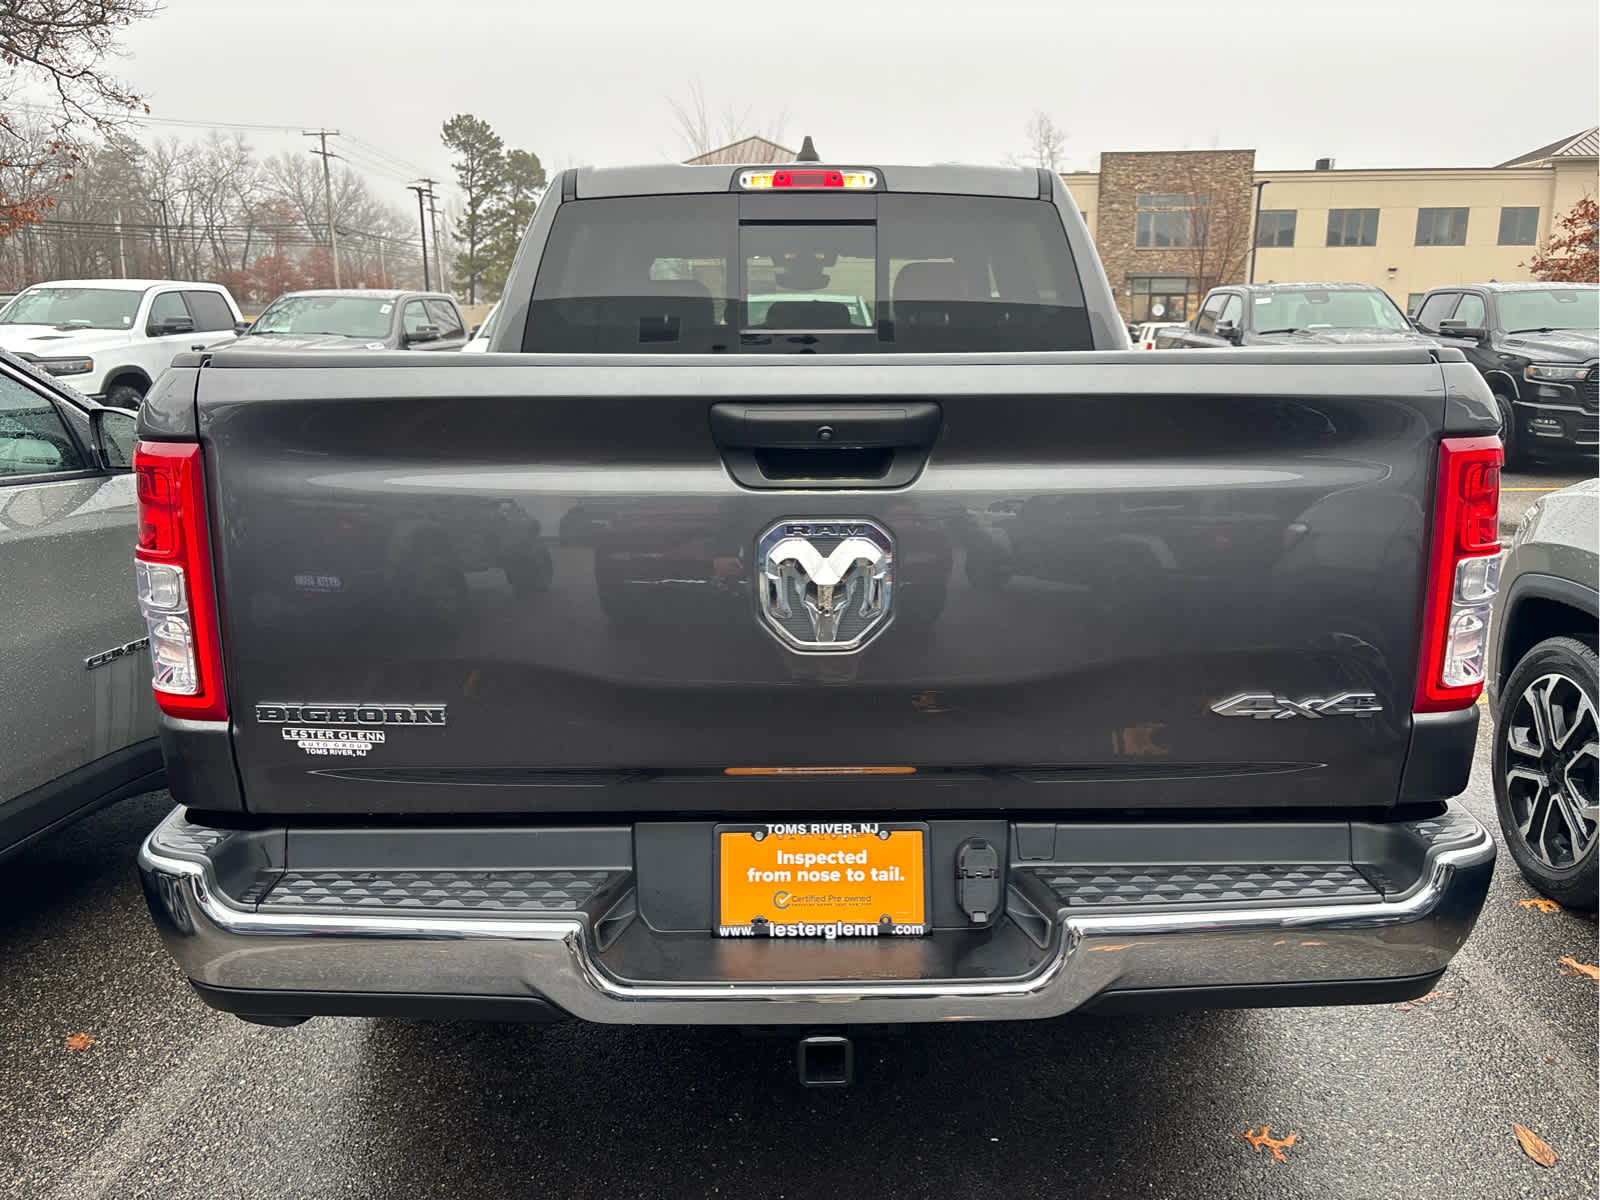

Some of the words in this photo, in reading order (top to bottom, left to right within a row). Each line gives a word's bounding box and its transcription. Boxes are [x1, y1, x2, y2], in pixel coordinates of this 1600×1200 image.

[784, 525, 865, 536] RAM
[83, 636, 151, 670] COMP
[255, 703, 447, 726] BIGHORN
[281, 728, 335, 740] LESTER
[338, 731, 385, 743] GLENN
[334, 742, 370, 750] GROUP
[766, 824, 807, 834] TOMS
[811, 824, 857, 835] RIVER,
[861, 823, 879, 834] NJ
[776, 850, 868, 868] Inspected
[747, 868, 791, 882] from
[797, 870, 841, 882] nose
[846, 868, 865, 882] to
[870, 866, 905, 882] tail.
[791, 895, 826, 903] Certified
[719, 925, 755, 937] www.
[769, 922, 879, 939] lesterglenn
[891, 923, 924, 935] .com
